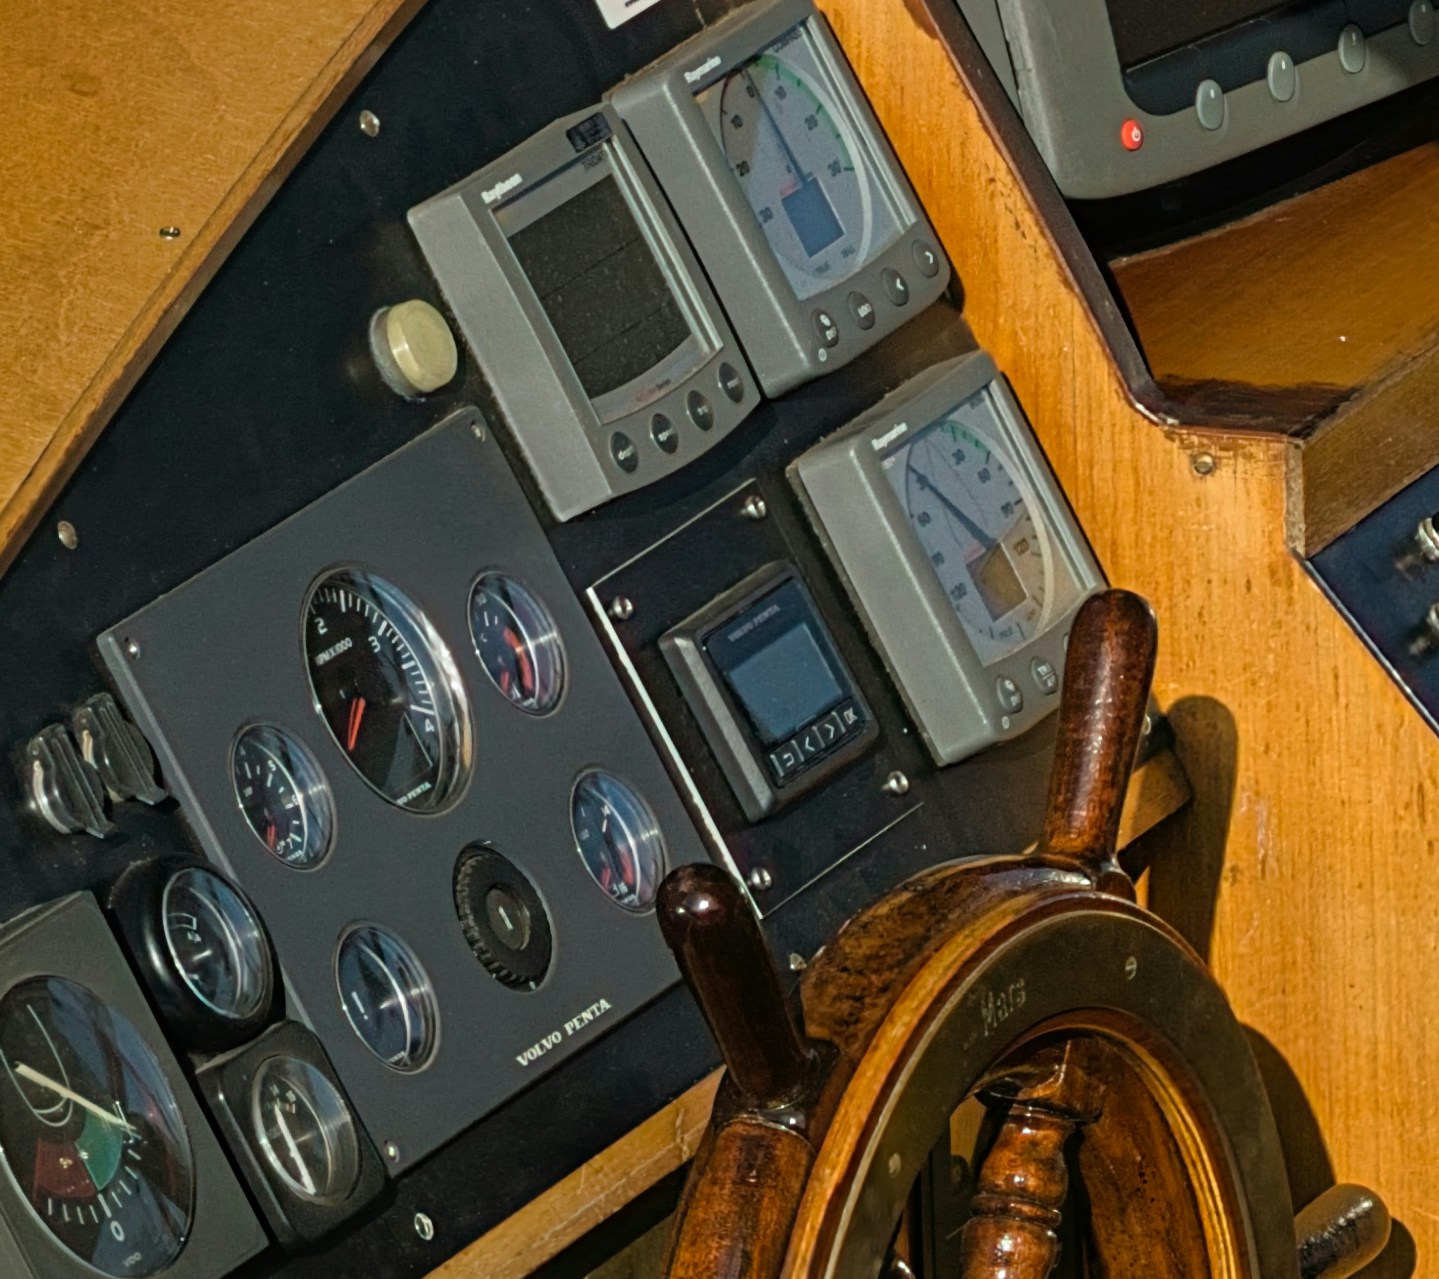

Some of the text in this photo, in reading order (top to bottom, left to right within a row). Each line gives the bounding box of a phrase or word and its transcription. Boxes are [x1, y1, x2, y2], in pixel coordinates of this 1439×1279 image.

[314, 618, 381, 653] 2 3
[424, 718, 436, 733] 4
[515, 998, 612, 1067] VOLVO PENTA
[110, 1221, 125, 1242] 0
